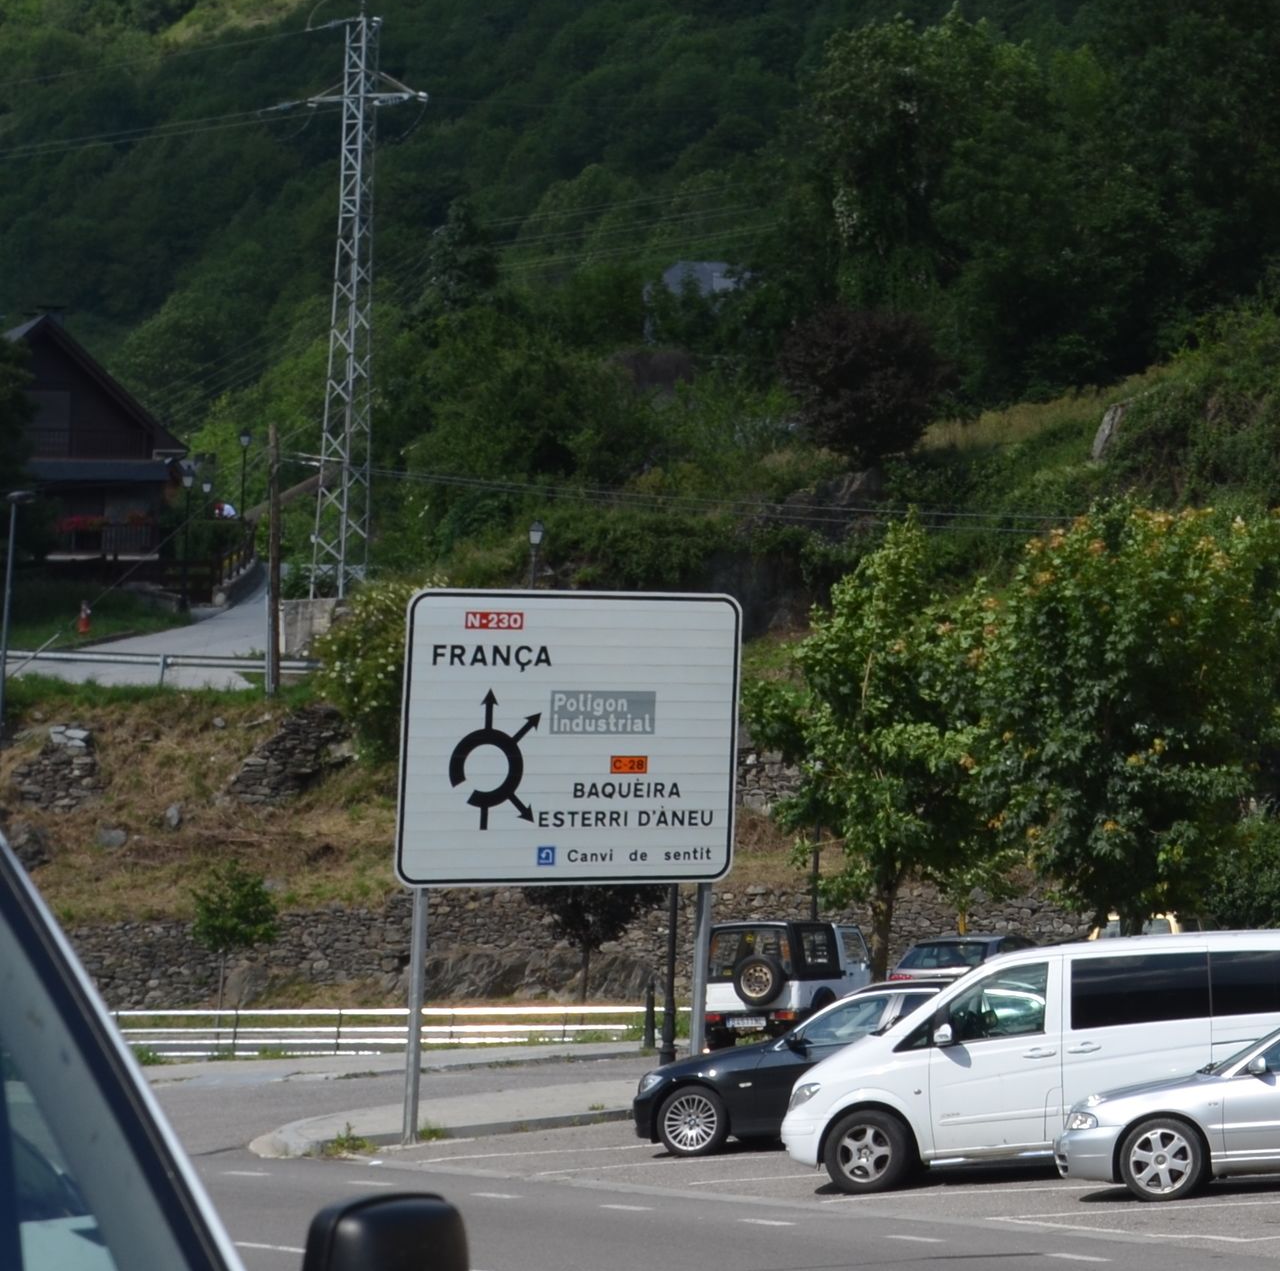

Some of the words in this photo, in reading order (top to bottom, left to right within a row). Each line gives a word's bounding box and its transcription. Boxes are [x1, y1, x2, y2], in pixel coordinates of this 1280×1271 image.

[467, 614, 522, 628] N-230
[432, 644, 552, 672] FRANÇA
[552, 713, 652, 732] Industrial
[613, 759, 645, 771] C-28
[572, 778, 681, 799] BAQUÈIRA
[538, 810, 628, 828] ESTERRI
[567, 849, 614, 863] Canvi
[628, 849, 648, 861] de
[664, 847, 712, 861] sentit
